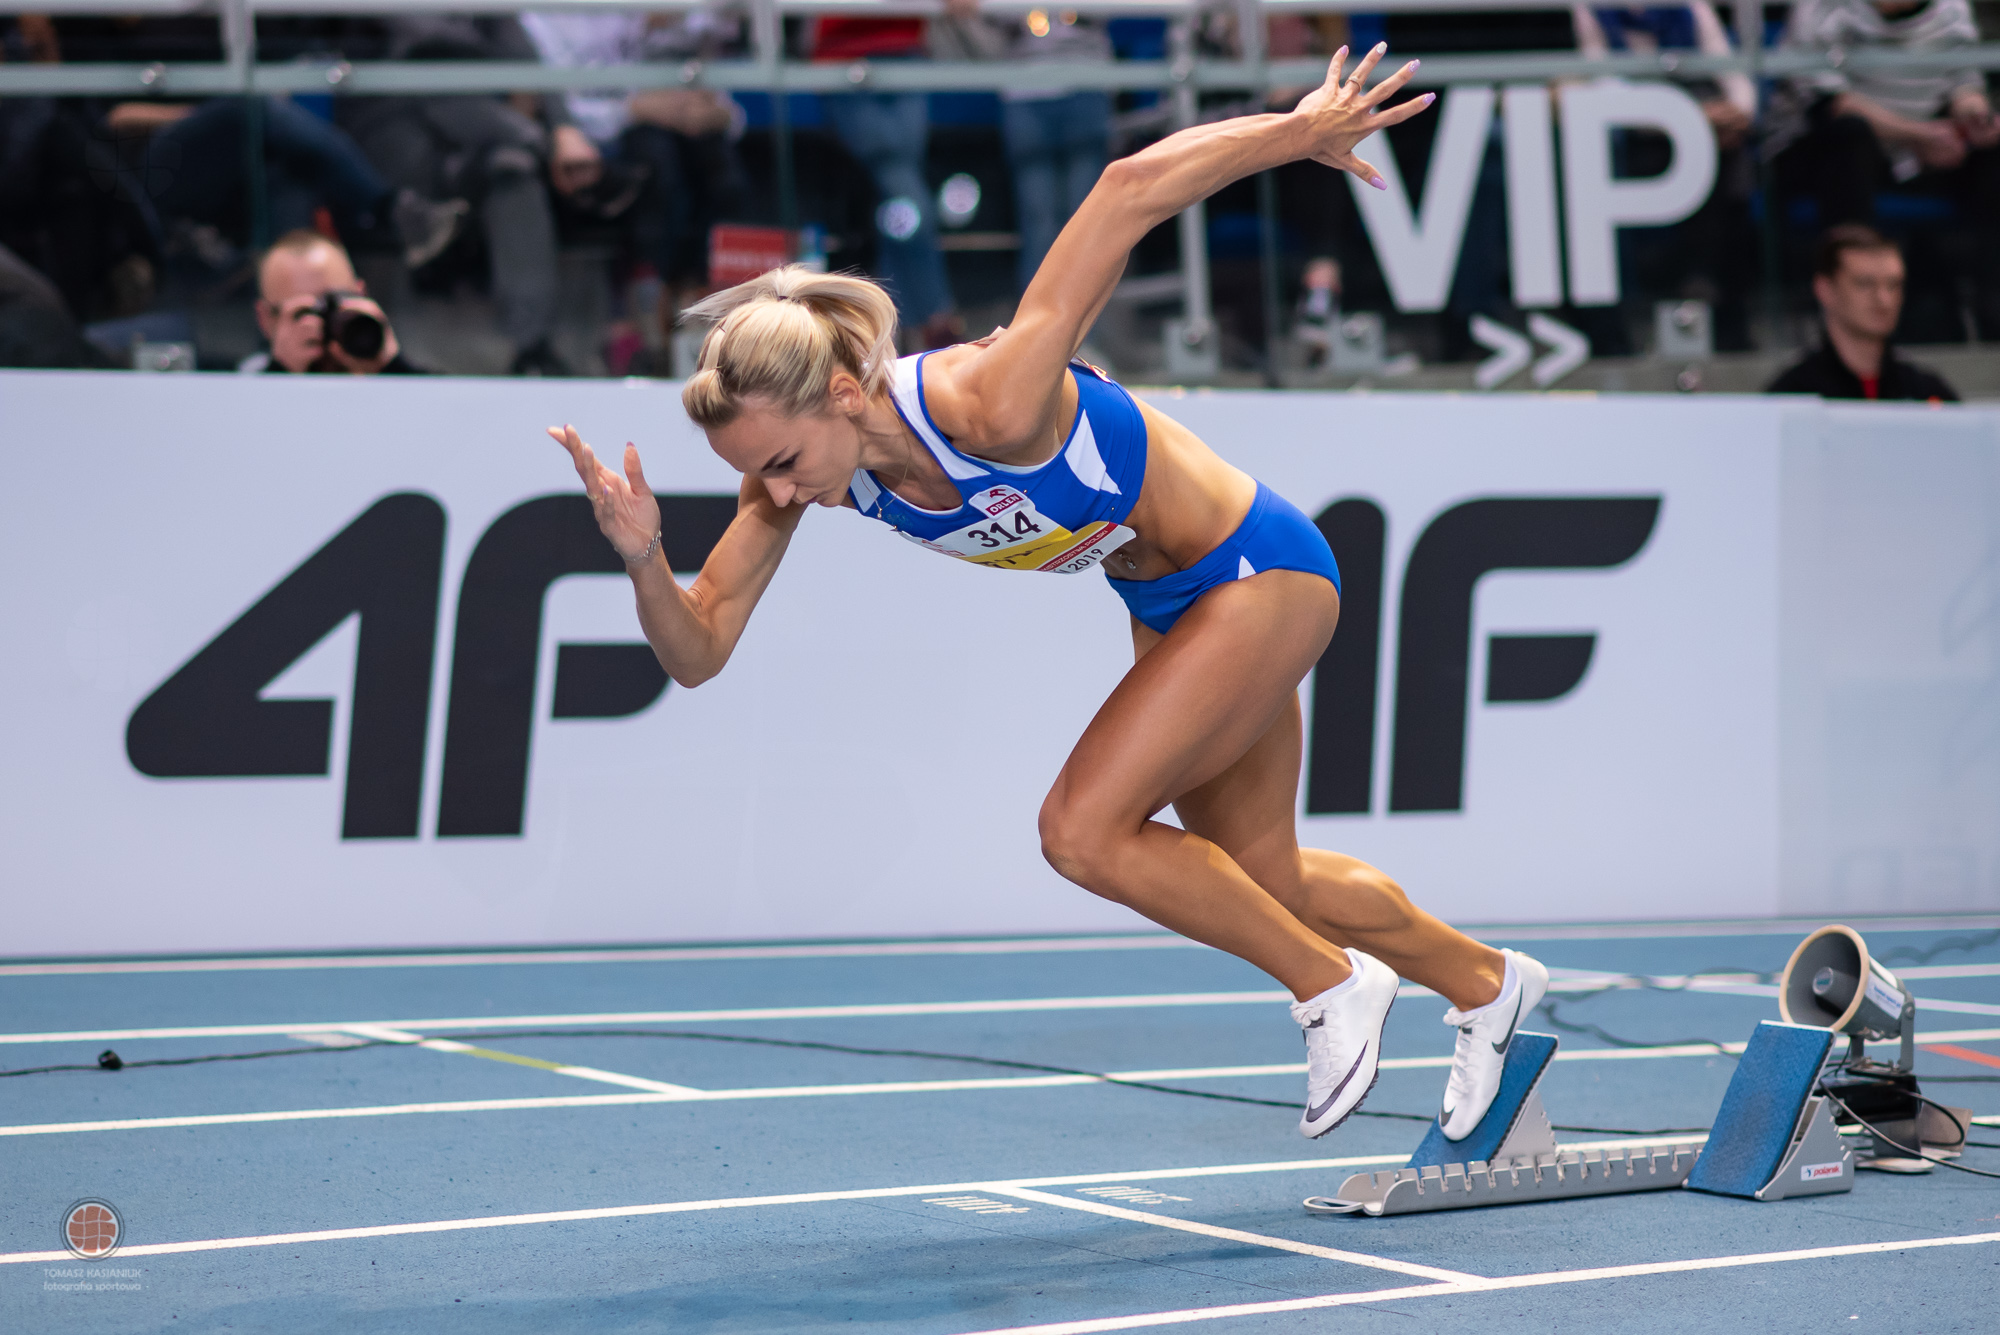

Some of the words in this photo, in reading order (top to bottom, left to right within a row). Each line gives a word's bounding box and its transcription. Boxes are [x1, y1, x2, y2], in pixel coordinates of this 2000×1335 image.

[1341, 79, 1719, 313] VIP
[990, 494, 1020, 513] ORLEN
[968, 510, 1042, 547] 314
[1067, 548, 1104, 571] 2019
[126, 491, 740, 839] 4F
